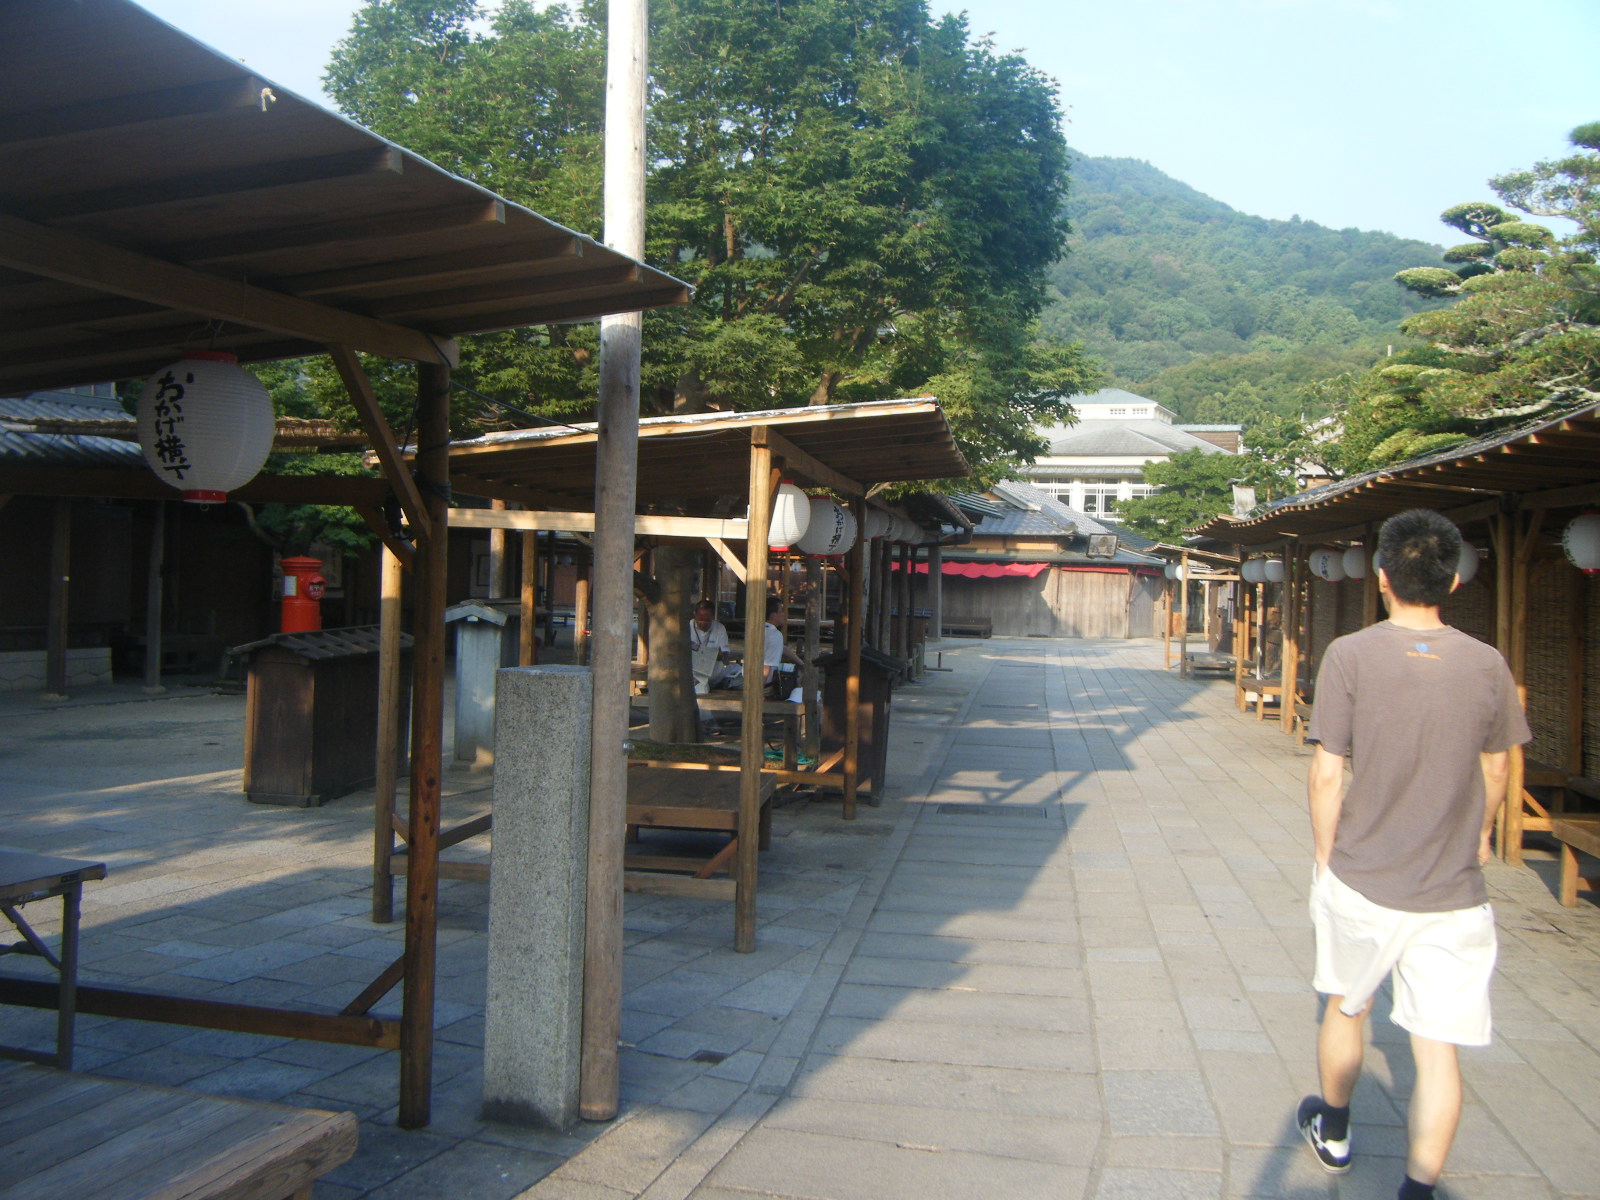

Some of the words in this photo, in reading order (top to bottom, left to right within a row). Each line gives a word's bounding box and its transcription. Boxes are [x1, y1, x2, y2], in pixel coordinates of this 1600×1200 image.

[154, 371, 194, 480] おかげ横丁
